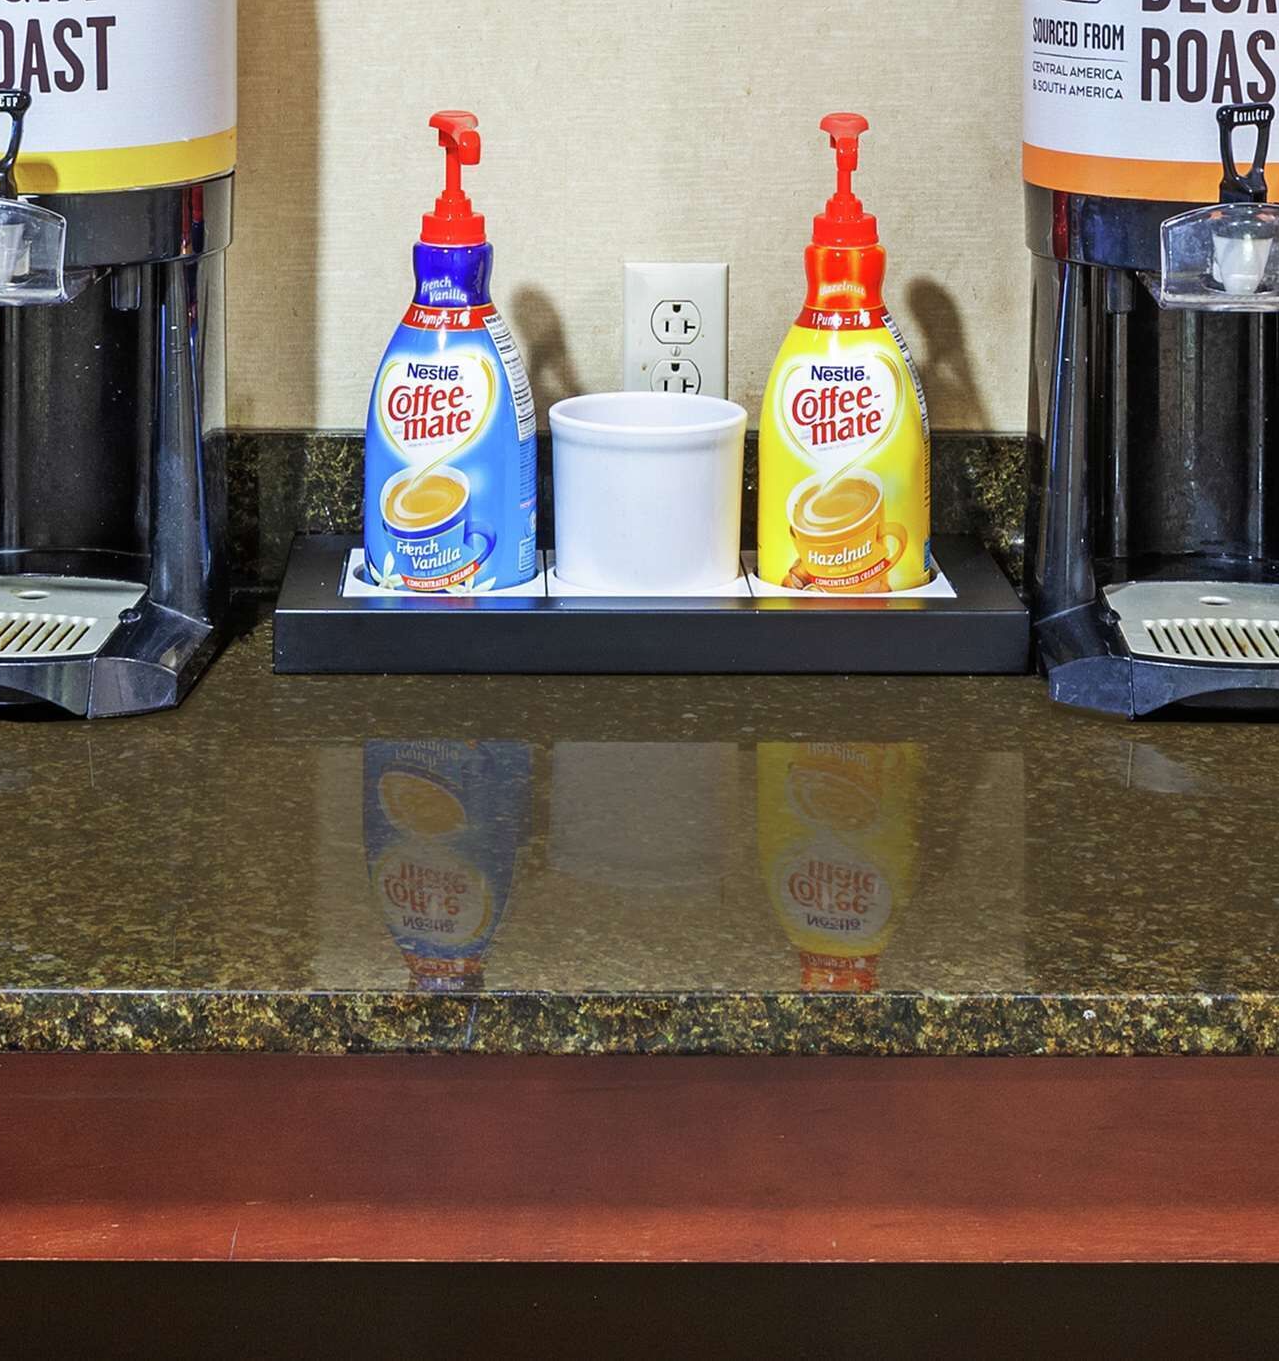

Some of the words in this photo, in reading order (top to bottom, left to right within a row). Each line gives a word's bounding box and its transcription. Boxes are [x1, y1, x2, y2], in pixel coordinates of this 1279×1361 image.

[1032, 17, 1078, 47] SOURCED
[1084, 23, 1124, 50] FROM
[1032, 60, 1068, 77] CENTRAL
[1070, 66, 1123, 81] AMERICA
[1038, 80, 1066, 95] SOUTH
[1069, 86, 1123, 100] AMERICA
[429, 288, 468, 303] Vanilla
[404, 410, 471, 441] mate
[811, 410, 881, 445] mate
[396, 538, 439, 556] French
[412, 547, 461, 569] Vanilla
[808, 540, 872, 566] Hazelnut
